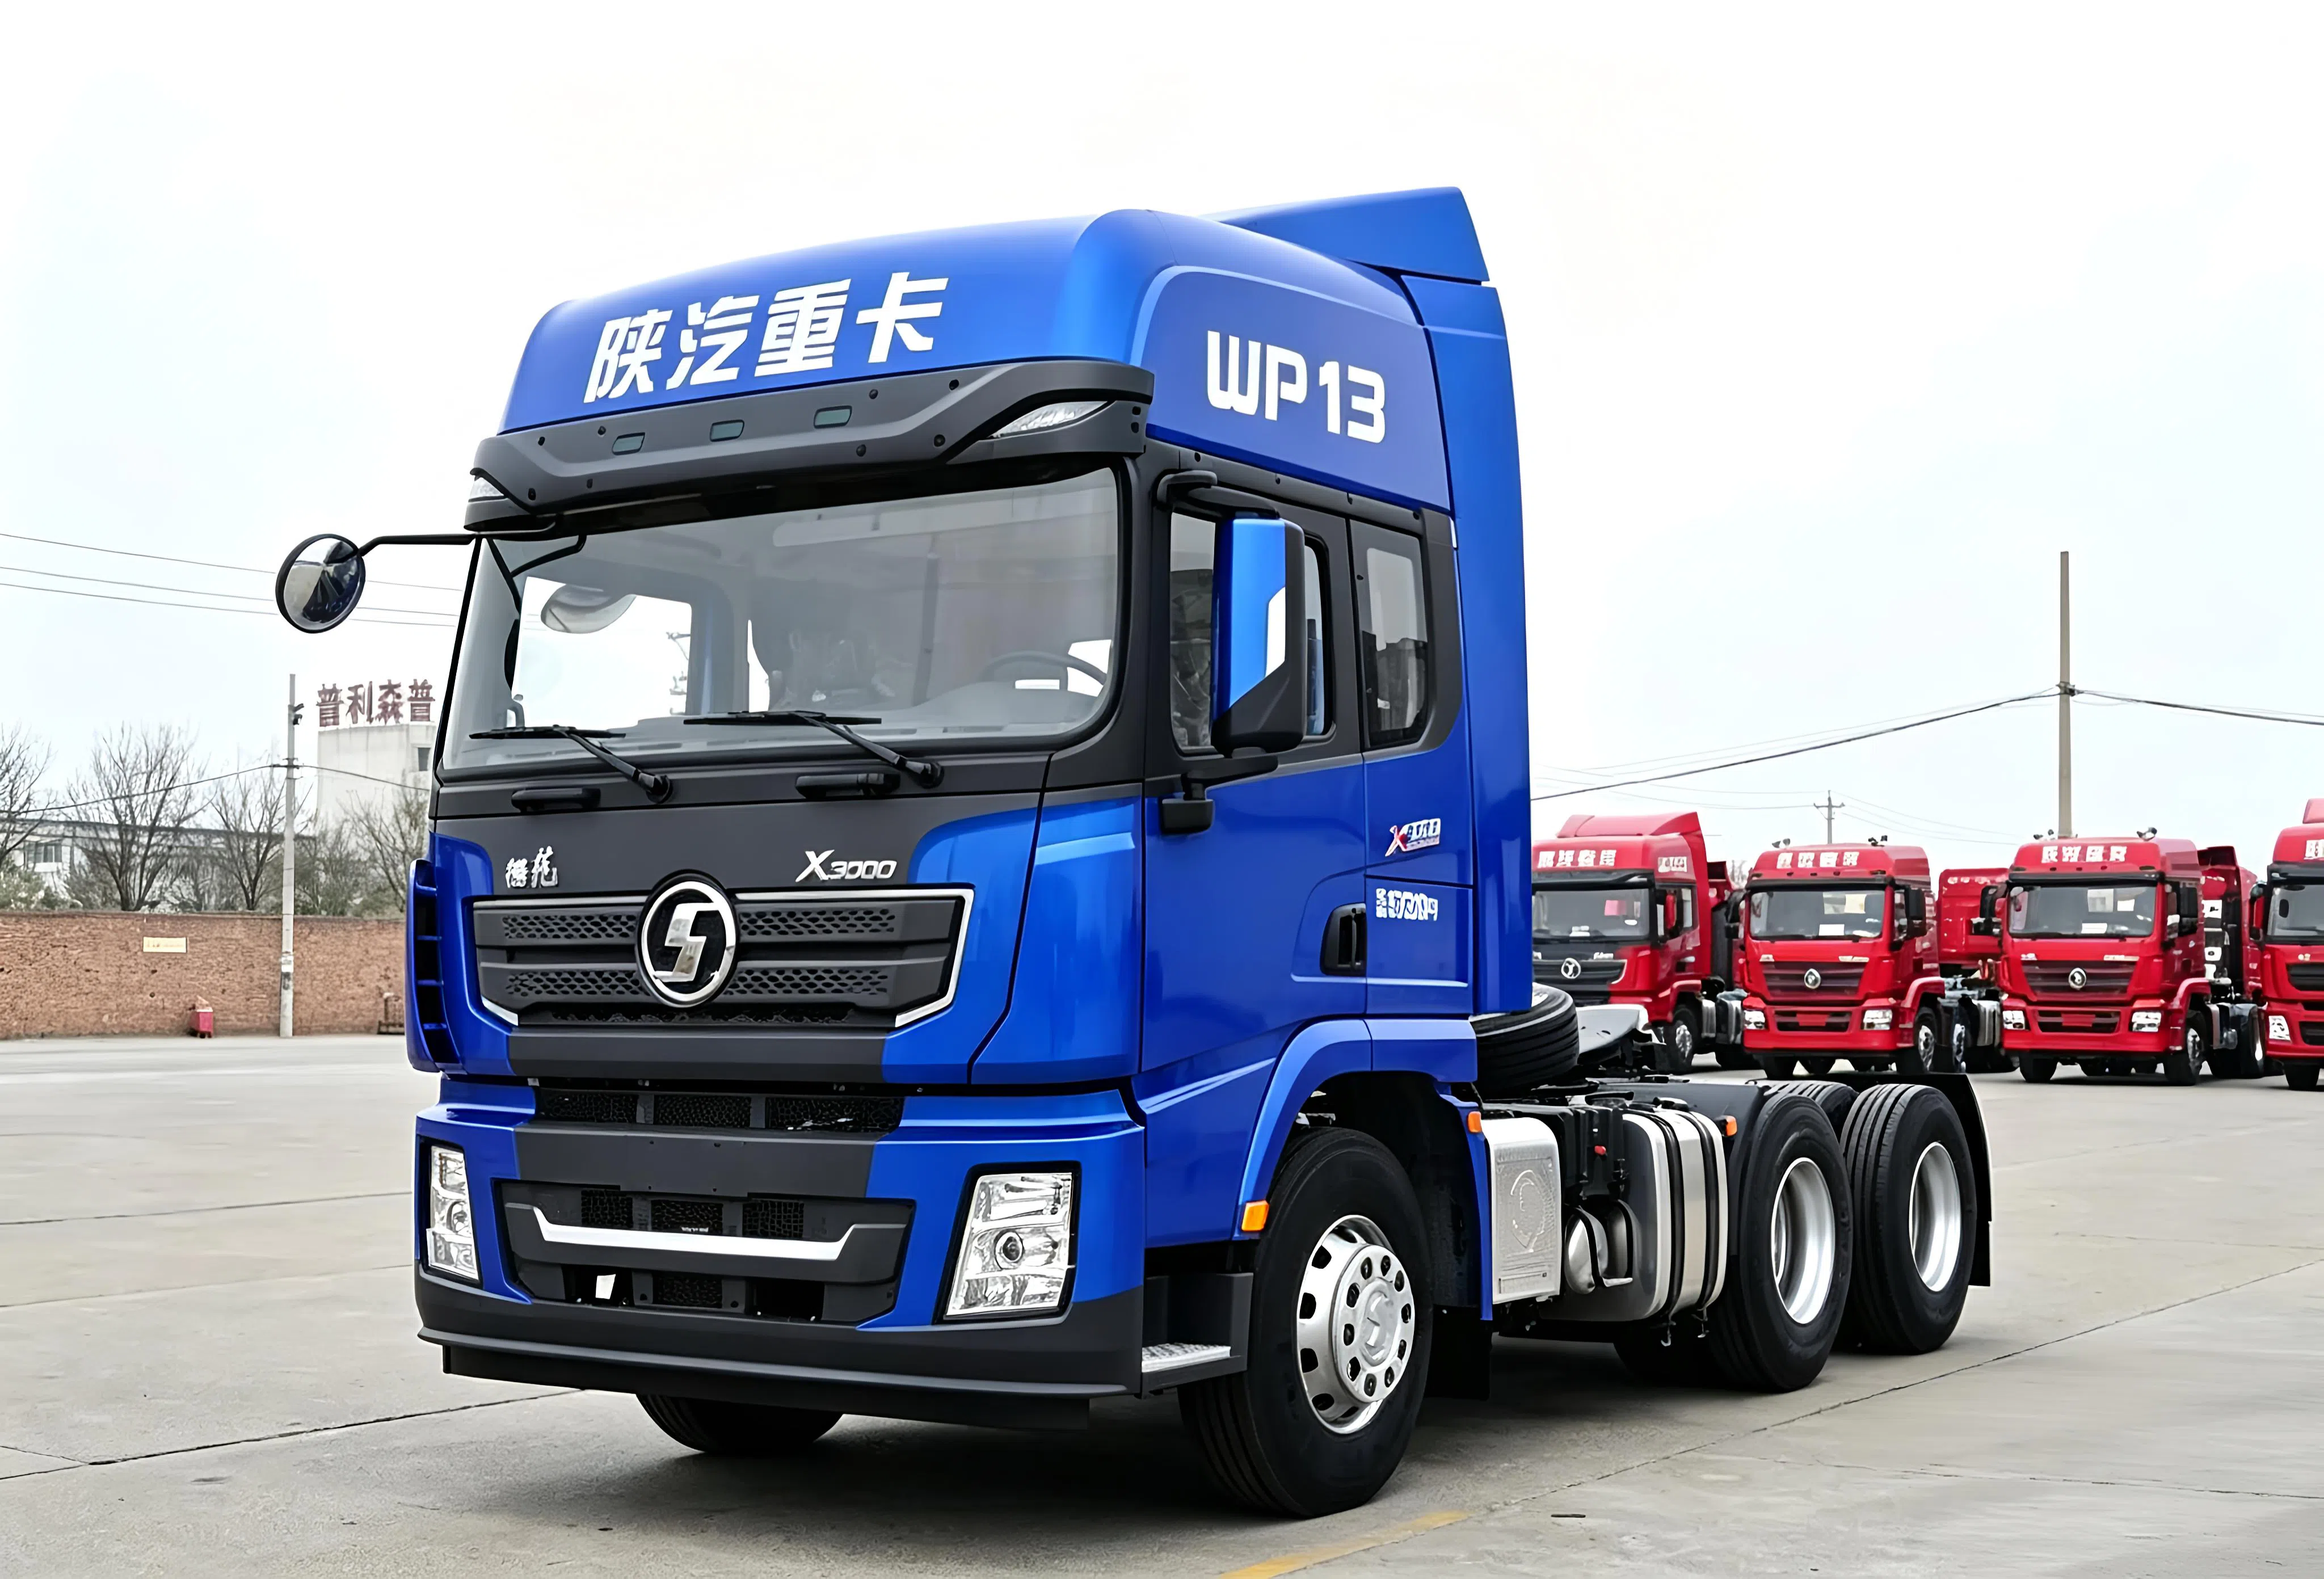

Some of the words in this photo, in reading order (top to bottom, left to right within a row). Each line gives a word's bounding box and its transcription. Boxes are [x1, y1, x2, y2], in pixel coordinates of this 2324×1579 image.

[583, 272, 949, 403] 陕汽重卡
[1207, 330, 1385, 443] WP13
[316, 679, 435, 727] 普利森普
[795, 849, 897, 882] X3000
